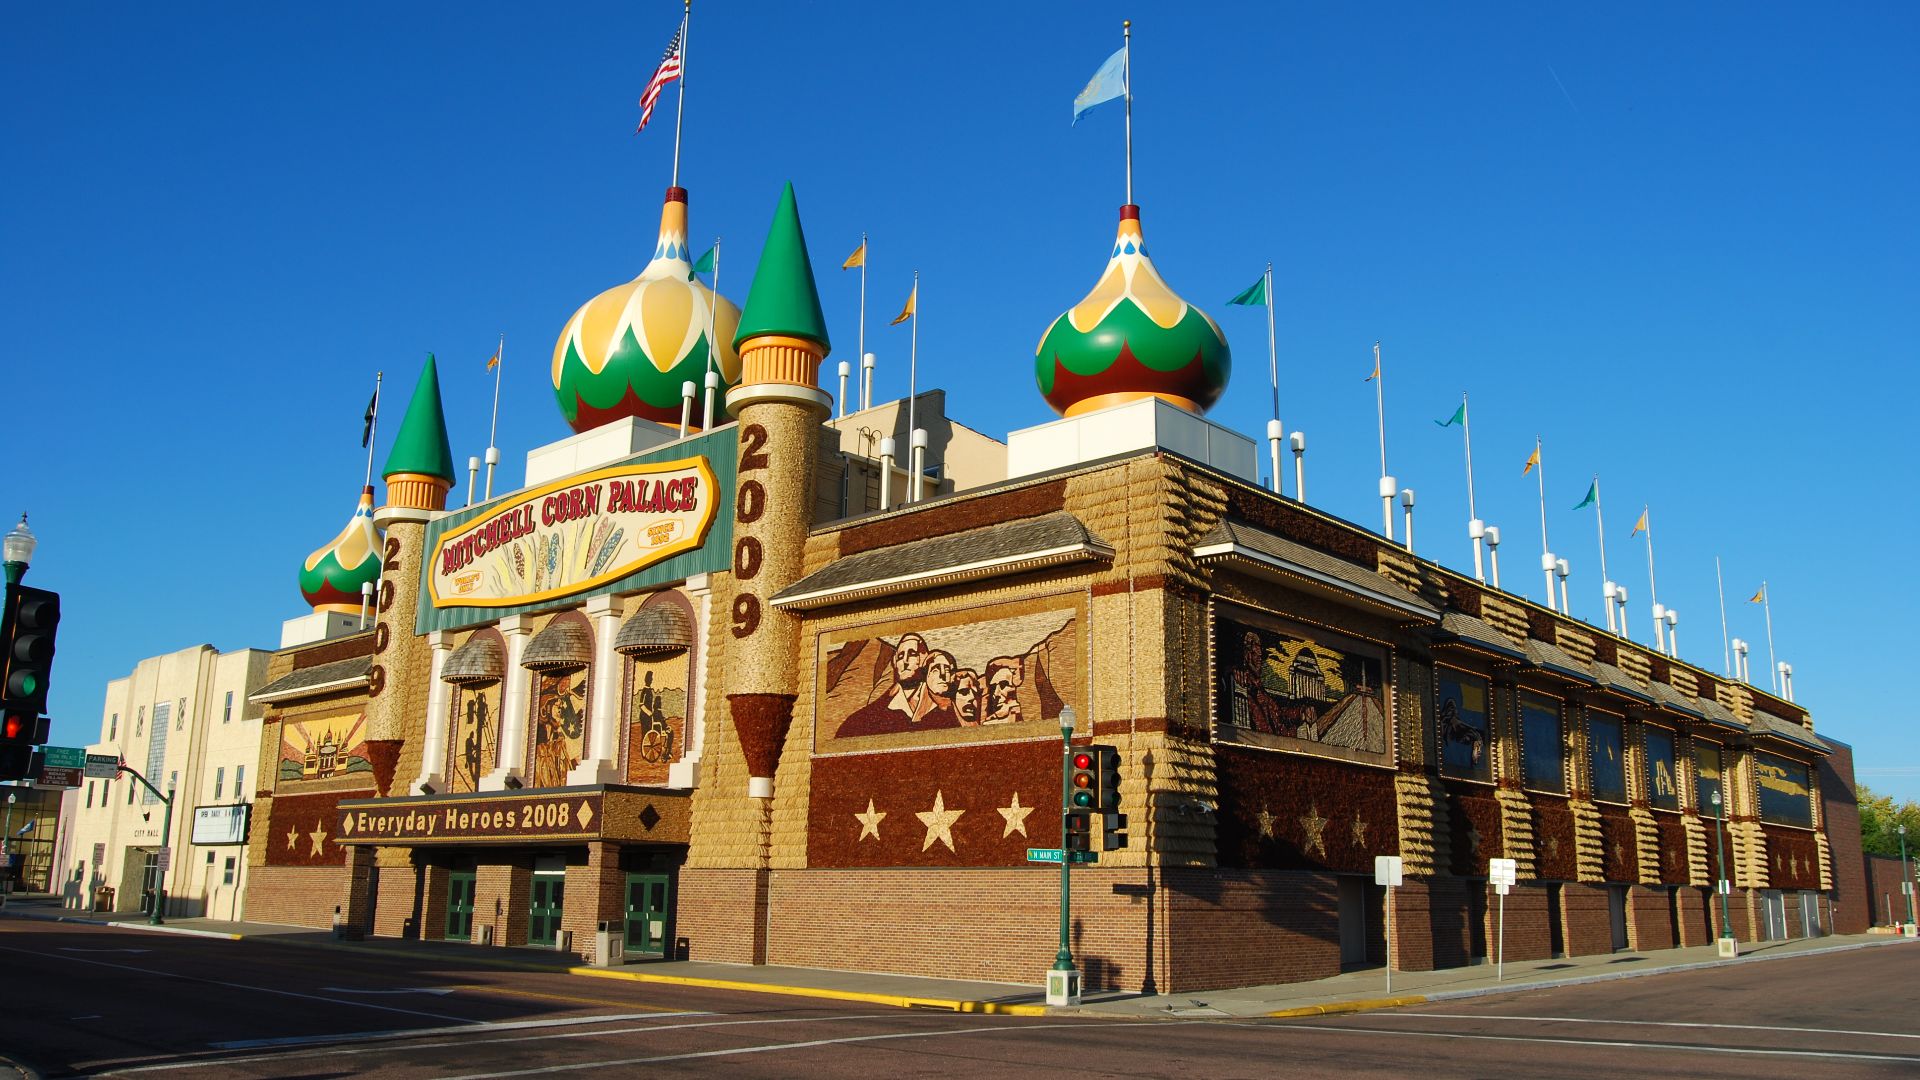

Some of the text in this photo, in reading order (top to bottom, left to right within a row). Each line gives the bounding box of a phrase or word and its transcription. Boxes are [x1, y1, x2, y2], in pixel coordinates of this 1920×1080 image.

[441, 476, 698, 576] MITCHELL CORN PALACE
[647, 522, 675, 537] SINCE
[88, 755, 117, 763] PARKING
[357, 802, 569, 836] Everyday Heroes 2008
[134, 829, 158, 837] CITY HALL
[1033, 851, 1060, 860] N MAIN ST
